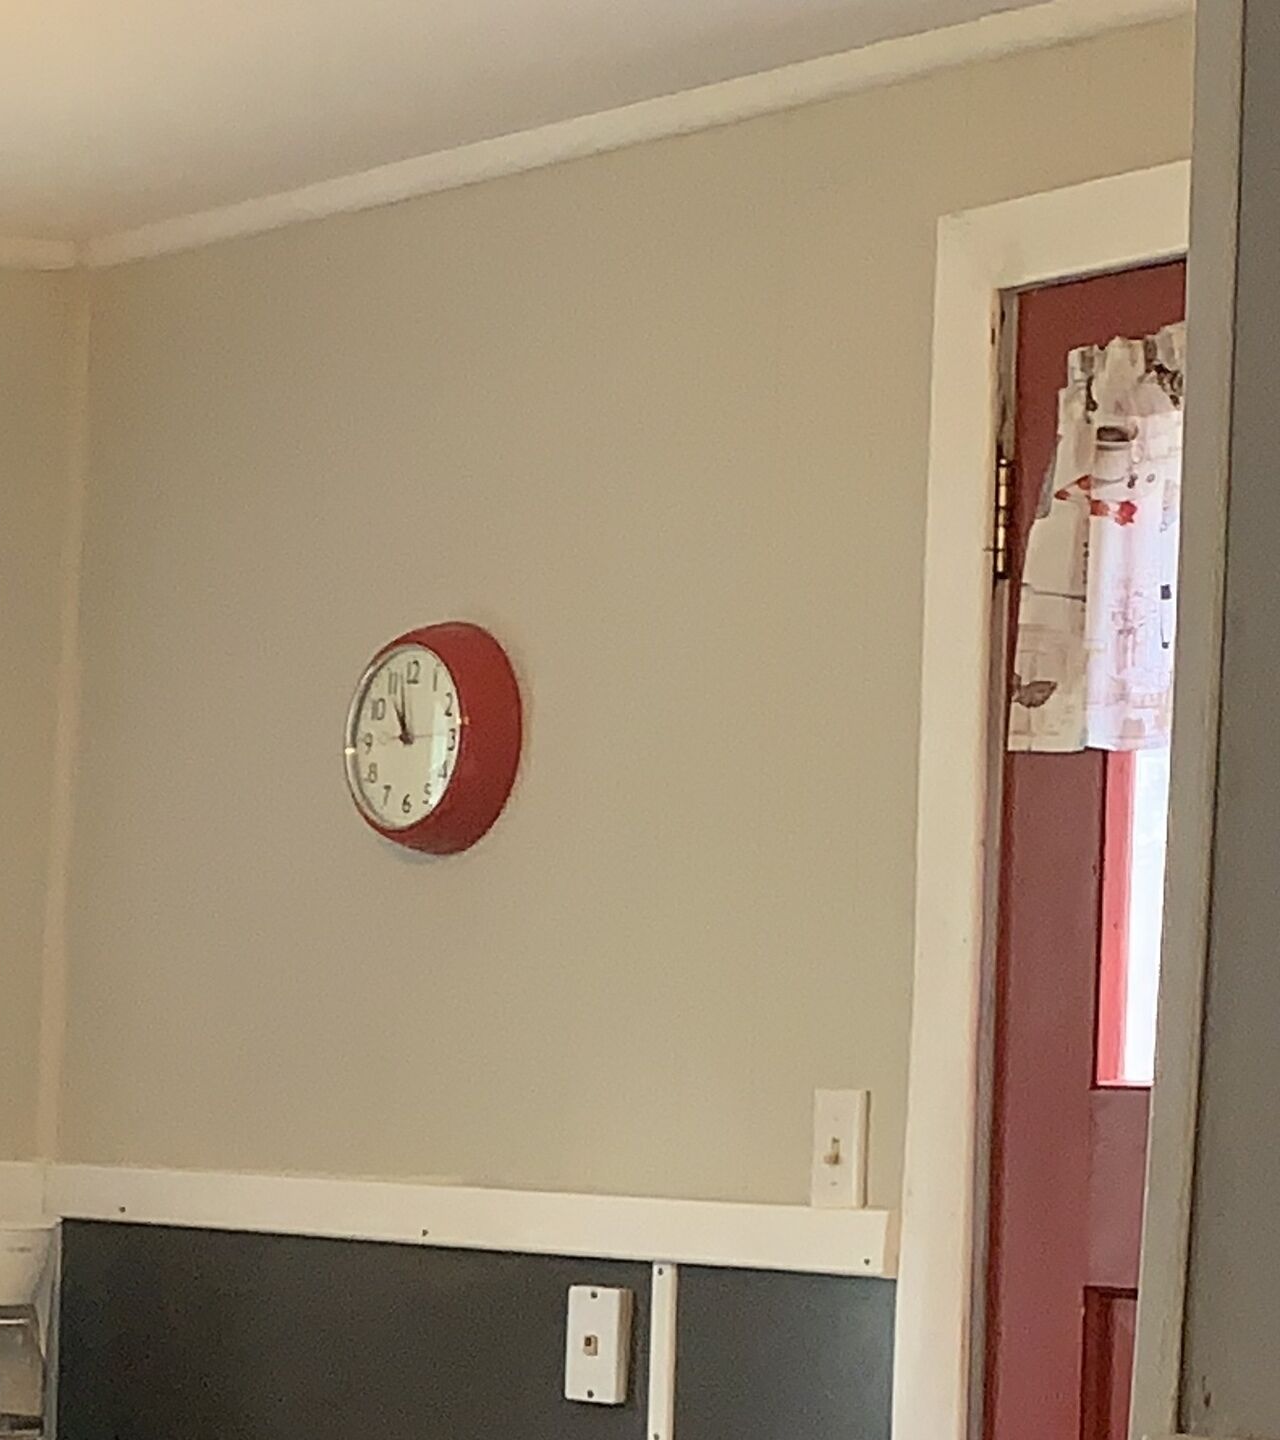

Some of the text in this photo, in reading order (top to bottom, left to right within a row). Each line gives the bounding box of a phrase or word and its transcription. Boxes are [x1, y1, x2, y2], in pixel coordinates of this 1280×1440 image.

[406, 660, 421, 684] 12
[371, 698, 386, 721] 10
[445, 692, 453, 717] 2
[364, 732, 373, 755] 9
[448, 728, 456, 751] 3
[368, 763, 378, 783] 8
[384, 785, 392, 806] 7
[402, 794, 413, 814] 6
